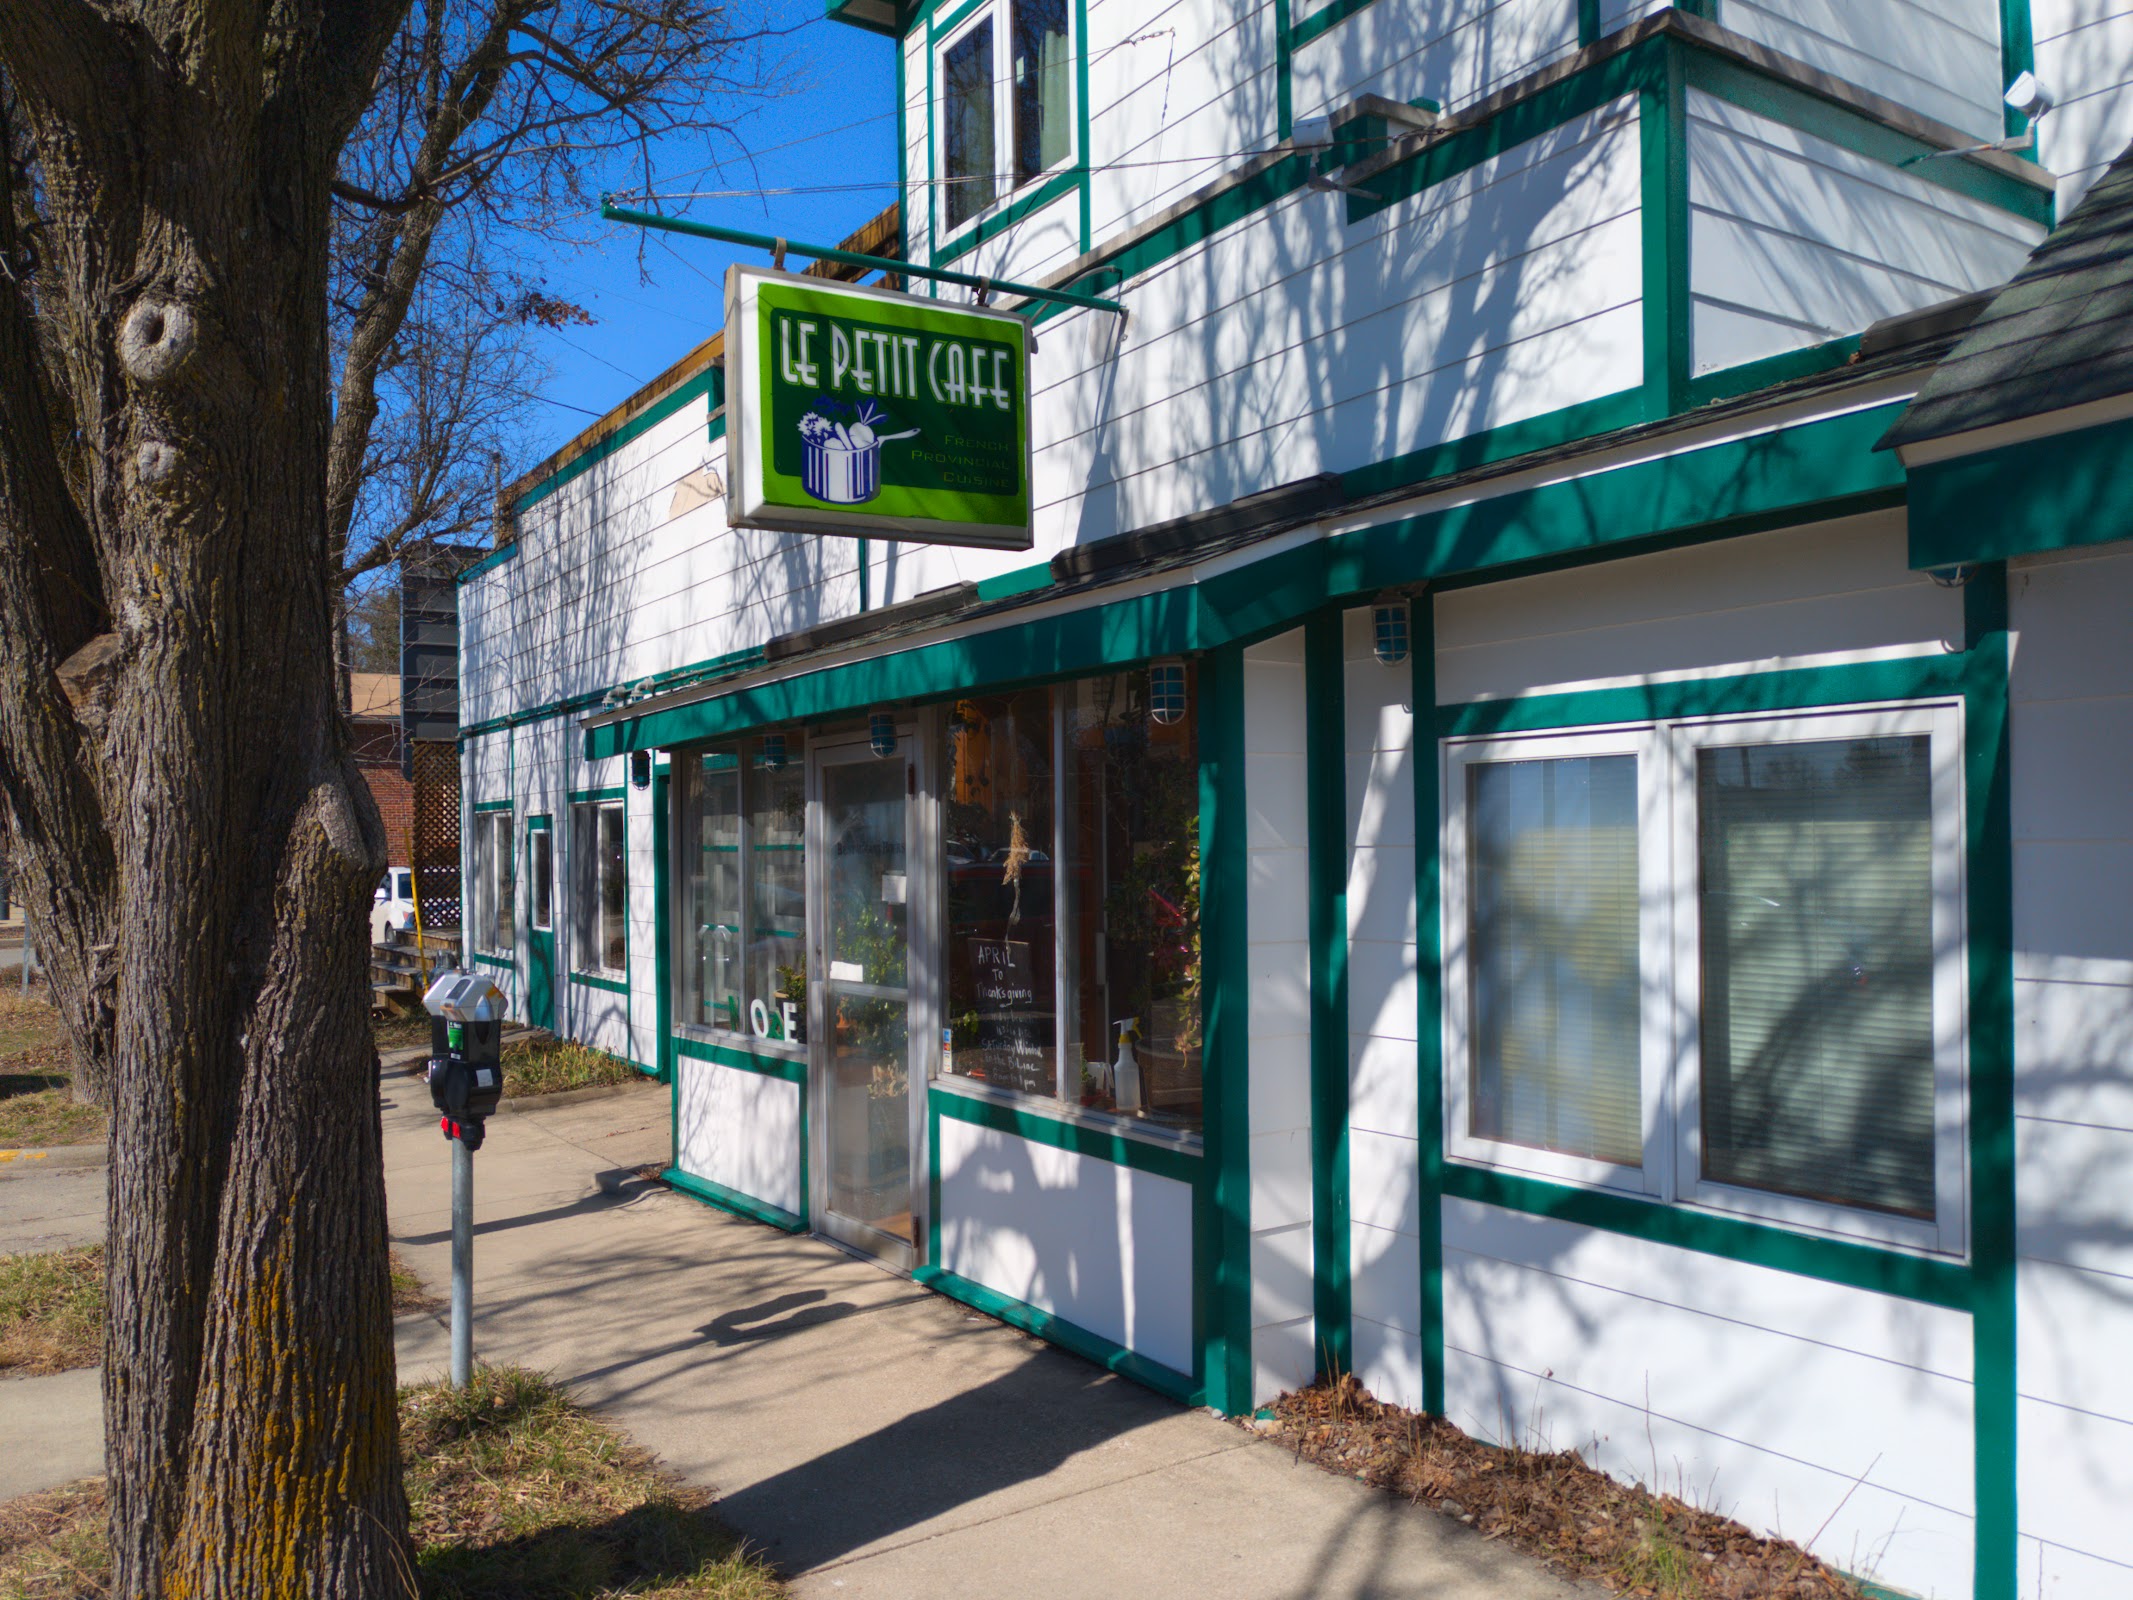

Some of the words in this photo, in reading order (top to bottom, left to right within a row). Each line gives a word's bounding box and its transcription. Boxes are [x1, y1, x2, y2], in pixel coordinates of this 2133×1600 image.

[780, 317, 819, 388] LE
[829, 320, 920, 400] PETIT
[927, 340, 1010, 411] CAFE
